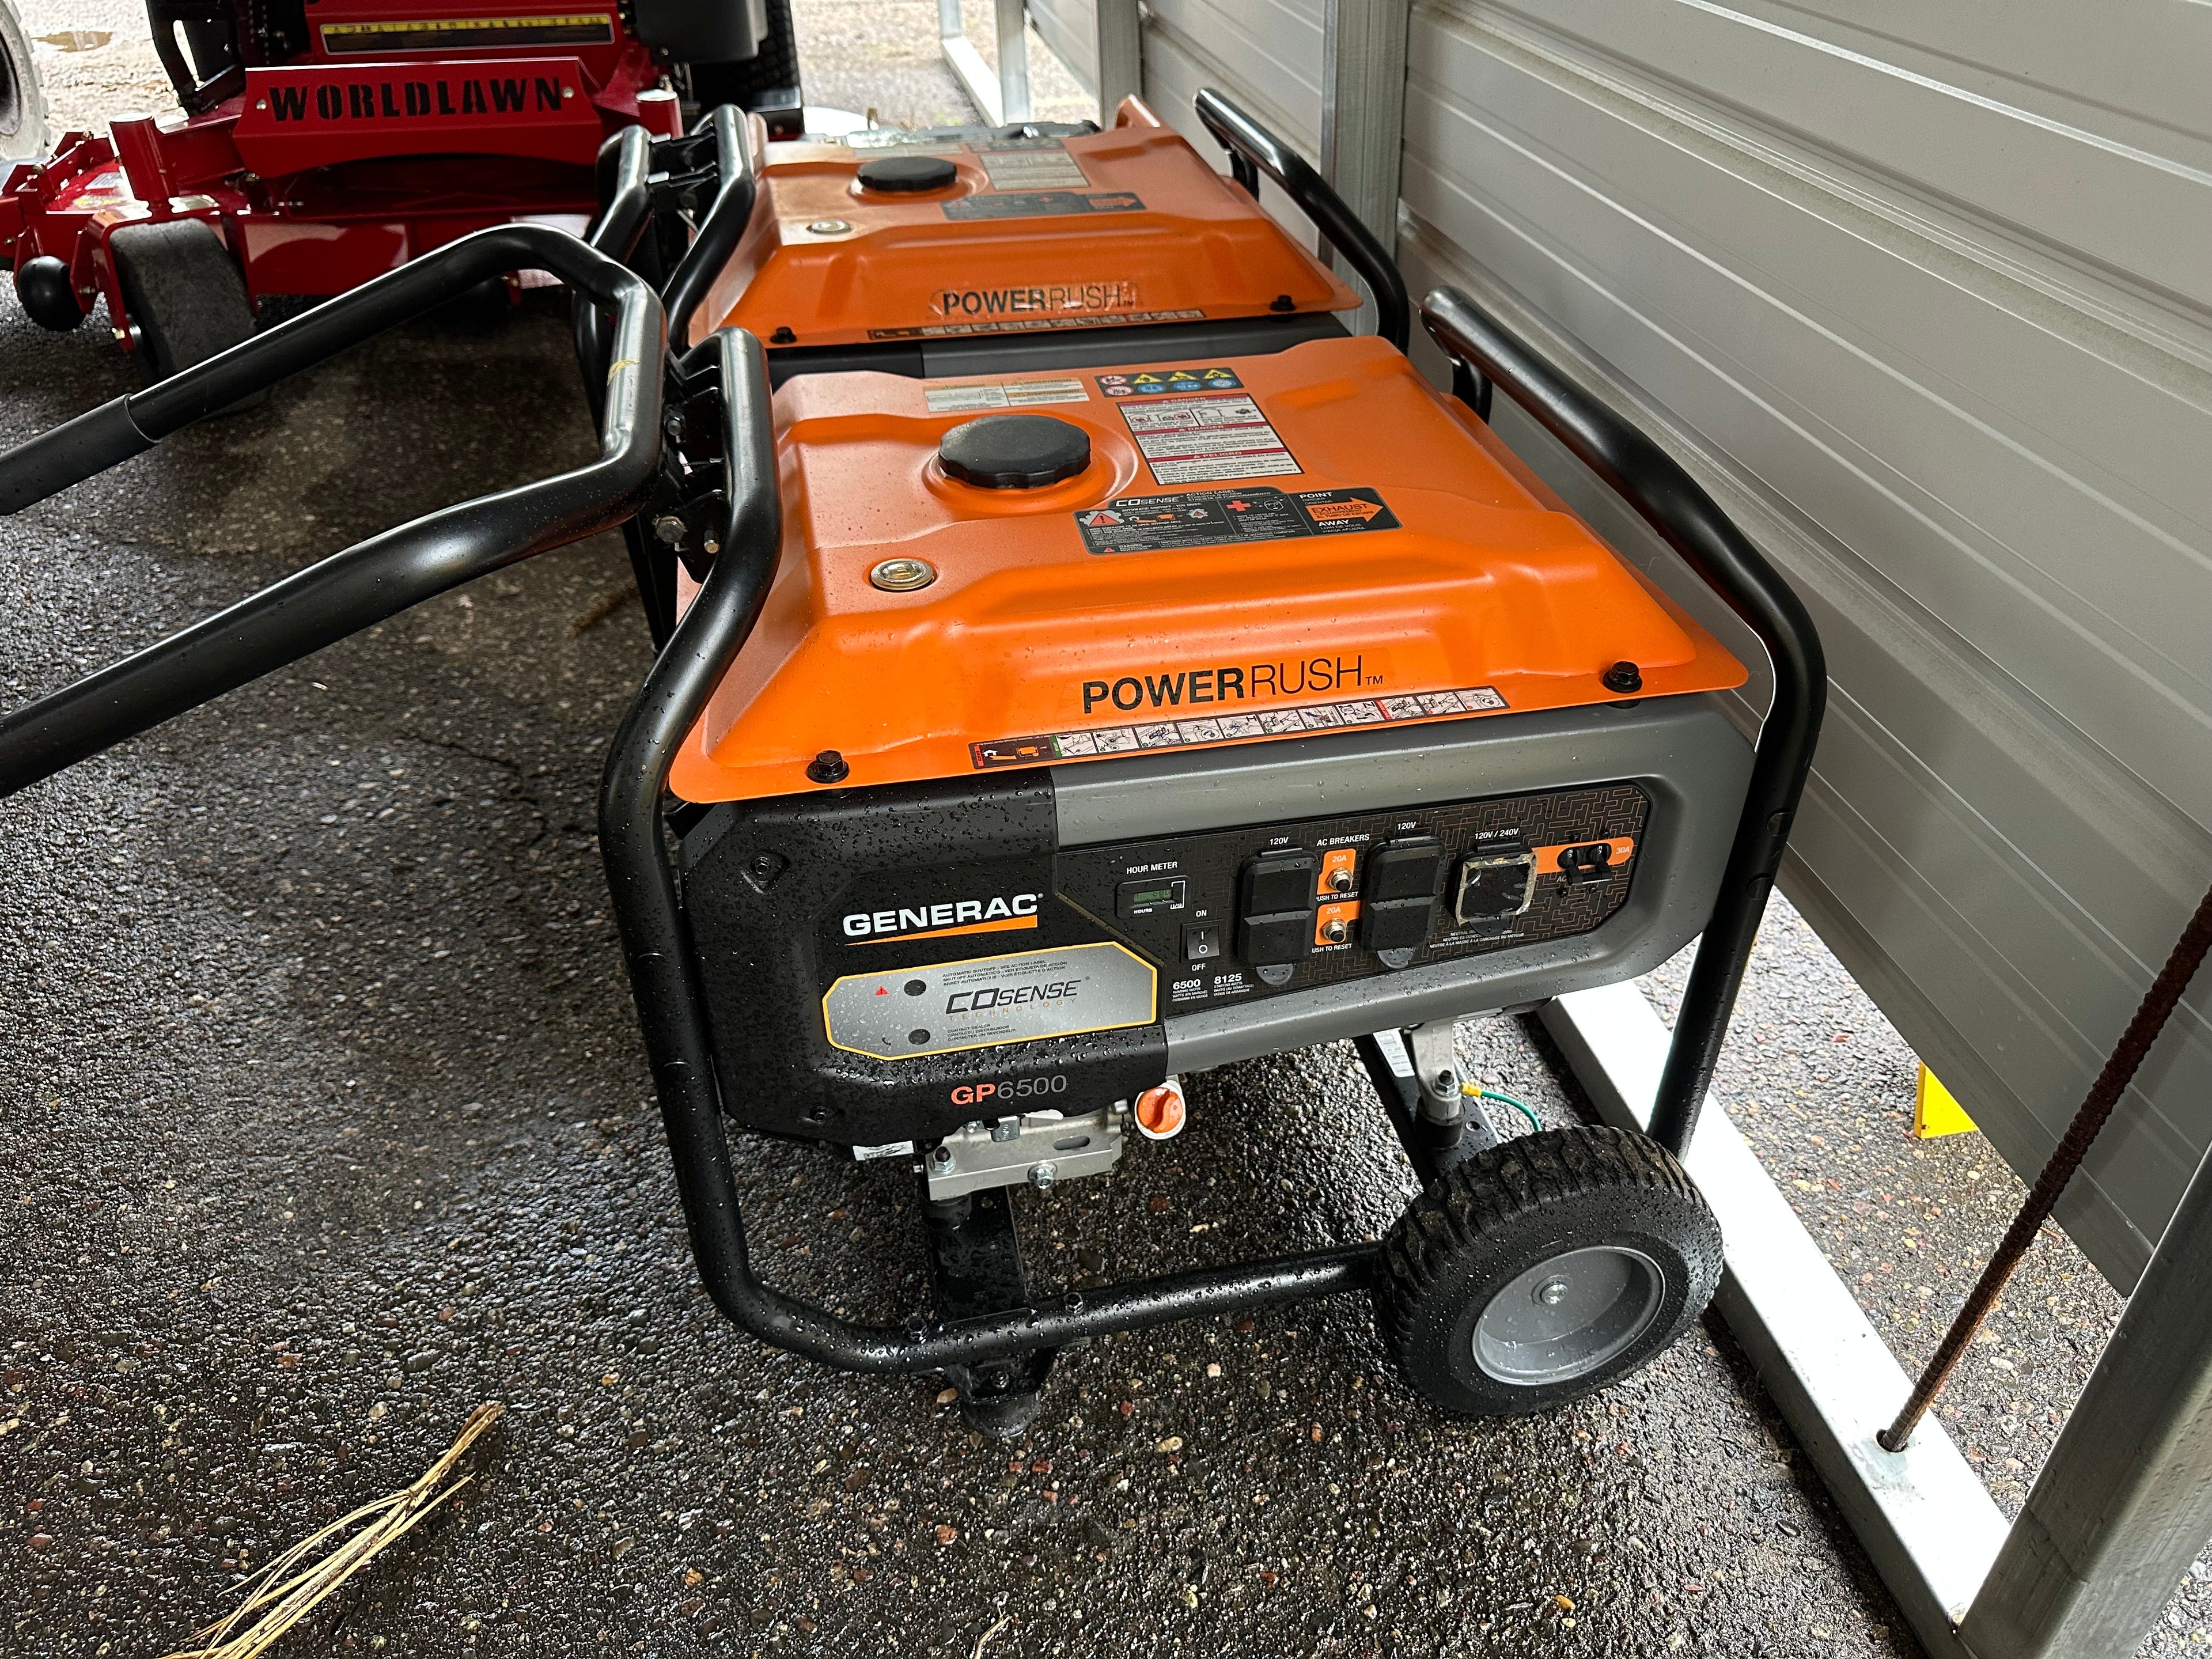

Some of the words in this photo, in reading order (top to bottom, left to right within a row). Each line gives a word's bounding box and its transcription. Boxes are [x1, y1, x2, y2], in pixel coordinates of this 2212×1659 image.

[269, 77, 562, 122] WORLDLAWN
[942, 285, 1122, 316] POWERRUSH
[1311, 503, 1368, 513] EXHAUST
[1084, 655, 1363, 714] POWERRUSH
[1396, 821, 1416, 831] 120V
[1475, 831, 1493, 840] 120V
[1499, 828, 1520, 837] 240V
[1269, 836, 1289, 846] 120V
[1316, 838, 1328, 847] AC
[1328, 834, 1370, 846] BREAKERS
[1615, 846, 1630, 855] 30A
[1332, 855, 1347, 863] 20A
[1126, 863, 1149, 874] HOUR
[1150, 861, 1178, 873] METER
[1556, 875, 1567, 883] AC
[1339, 891, 1358, 900] RESET
[843, 894, 1037, 937] GENERAC
[1195, 909, 1207, 918] ON
[1326, 907, 1342, 915] 20A
[1334, 943, 1353, 952] RESET
[1191, 963, 1206, 972] OFF
[1214, 973, 1242, 984] 8125
[1172, 979, 1201, 990] 6500
[948, 997, 1076, 1021] TECHNOLOGY
[951, 1075, 1067, 1105] GP6500
